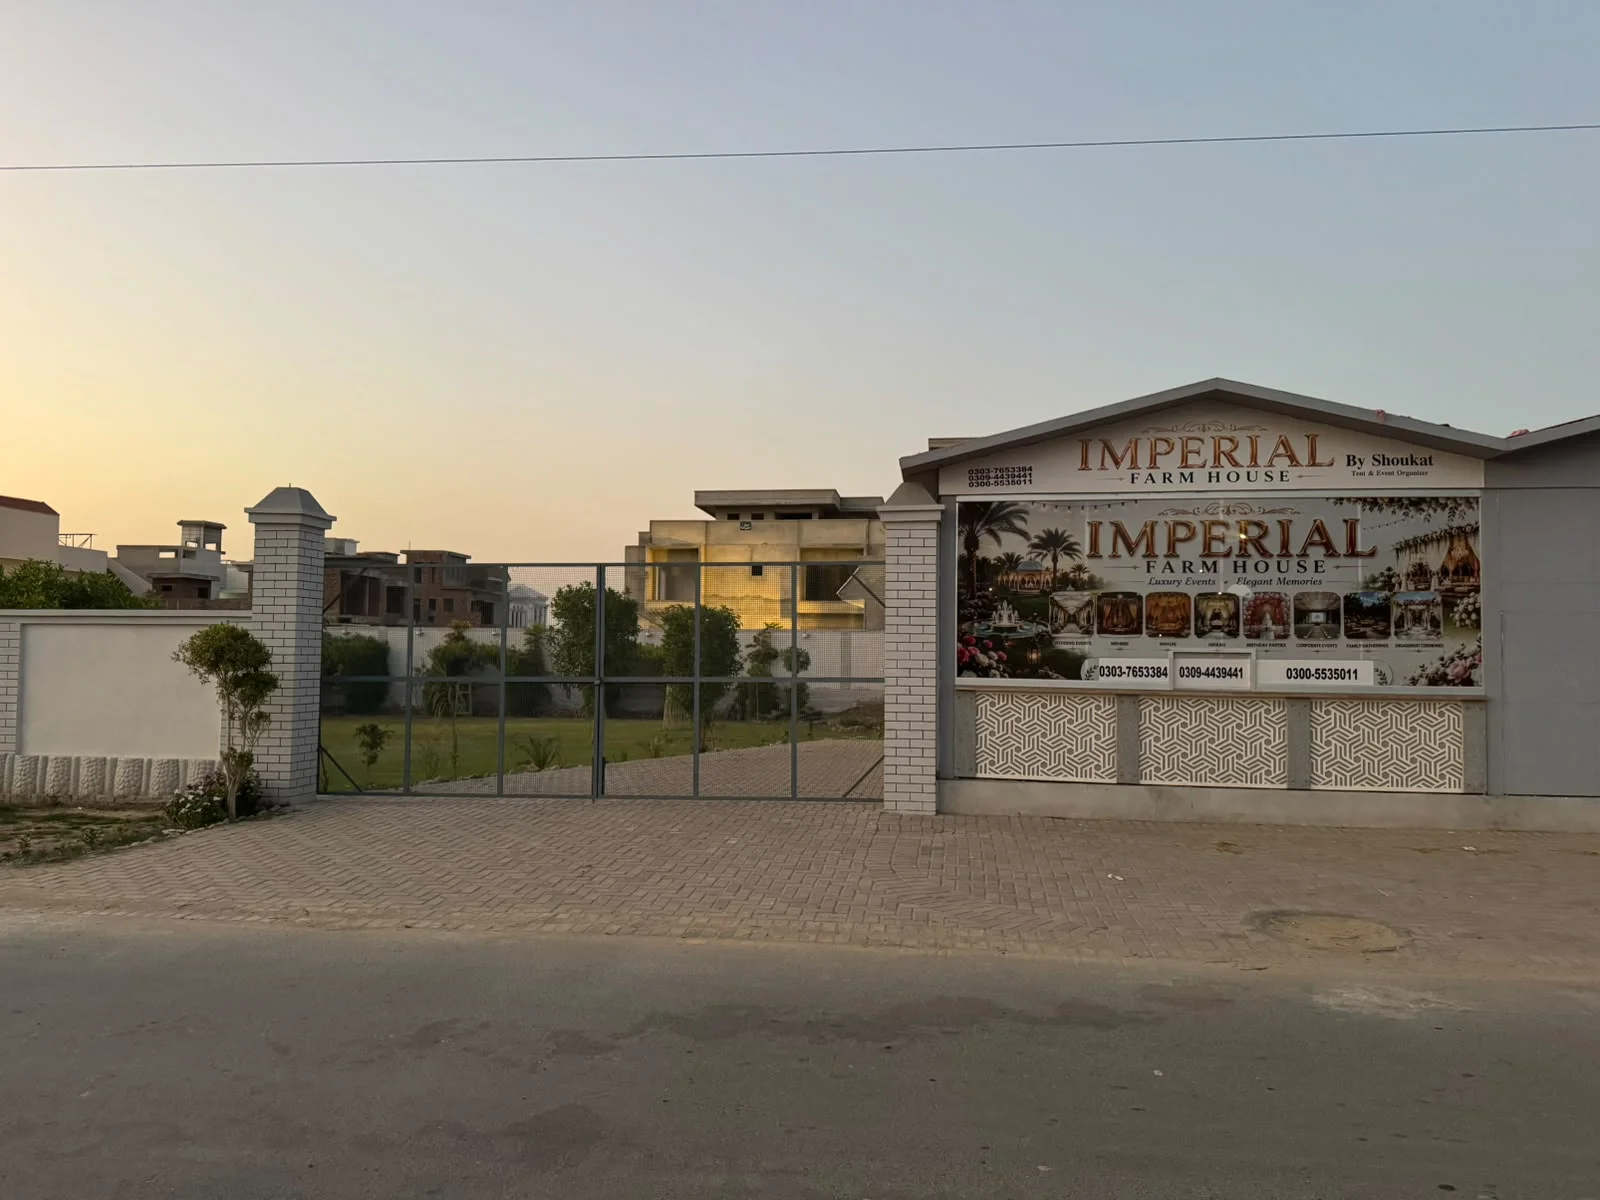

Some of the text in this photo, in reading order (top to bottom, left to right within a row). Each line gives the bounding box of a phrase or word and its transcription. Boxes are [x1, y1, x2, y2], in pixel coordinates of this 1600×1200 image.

[1078, 433, 1336, 471] IMPERIAL
[1345, 453, 1434, 469] By Shoukat
[968, 466, 1032, 475] 0303-7653384
[968, 473, 1032, 481] 0309-4439441
[1130, 470, 1291, 484] FARM HOUSE
[968, 479, 1032, 488] 0300-5535011
[1086, 518, 1378, 558] IMPERIAL
[1145, 560, 1326, 574] FARM HOUSE
[1147, 577, 1323, 587] Luxury Events Elegant Memories
[1099, 665, 1358, 681] 0303-7653384 0309-4439441 0300-5535011
